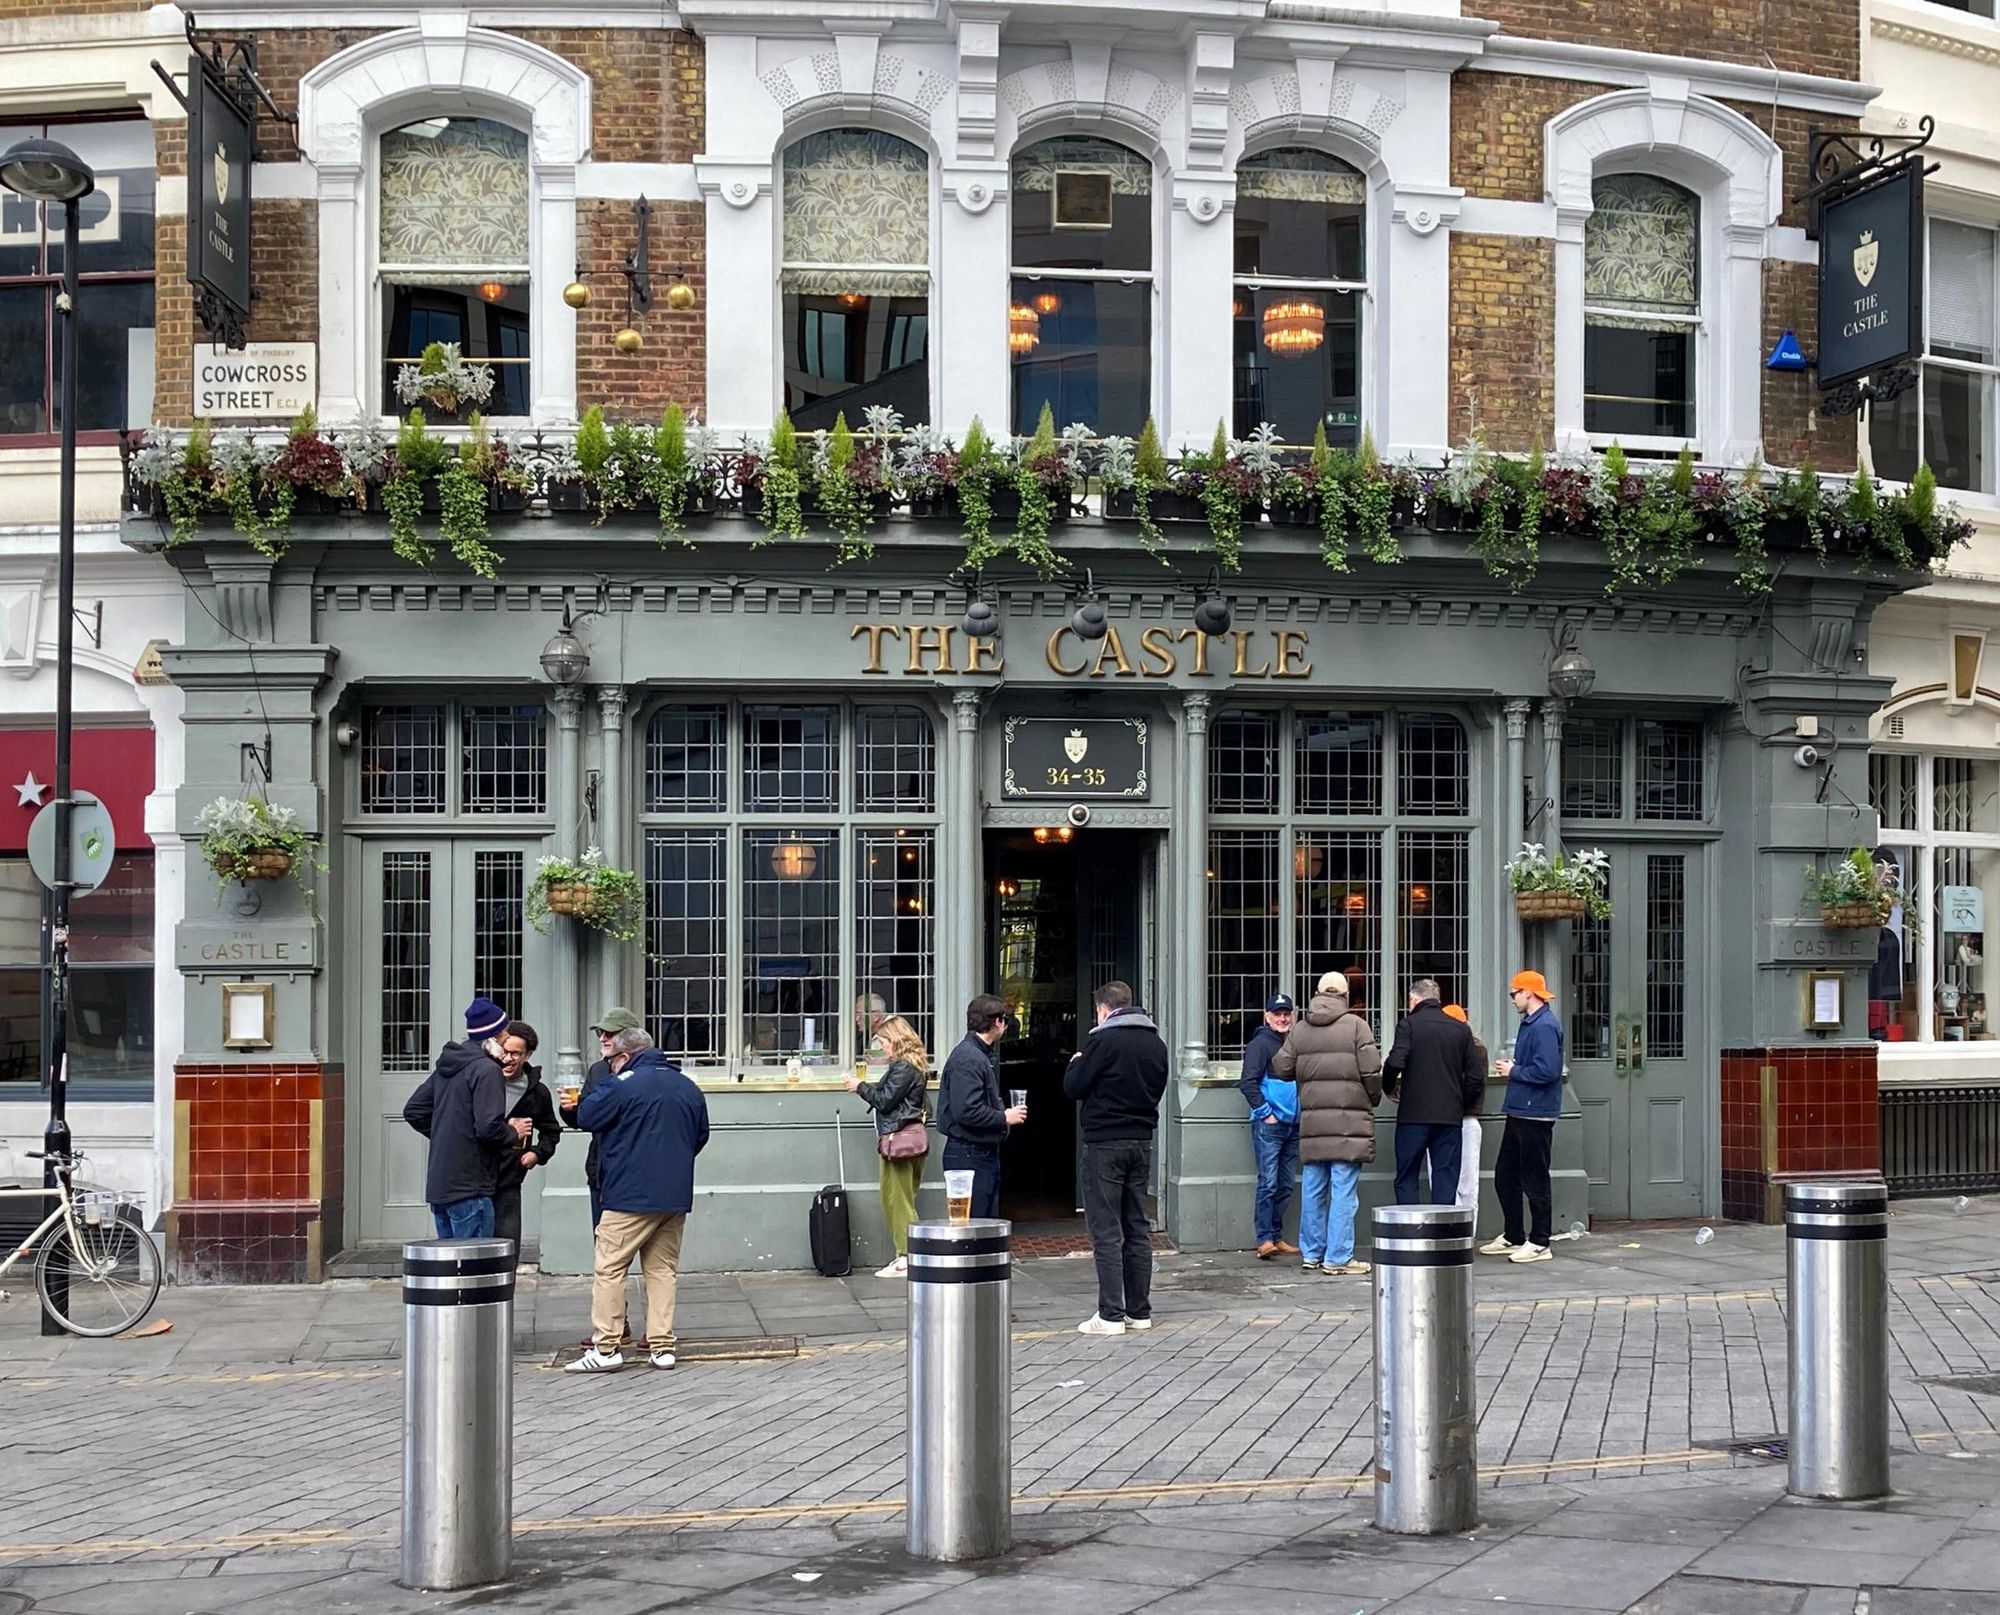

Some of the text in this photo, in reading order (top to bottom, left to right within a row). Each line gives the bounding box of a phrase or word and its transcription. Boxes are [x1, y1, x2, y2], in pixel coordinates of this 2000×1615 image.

[214, 210, 229, 237] THE
[208, 229, 235, 264] CASTLE
[1853, 293, 1878, 314] THE
[1843, 309, 1889, 338] CASTLE
[202, 364, 308, 383] COWCROSS
[202, 390, 274, 410] STREET
[850, 624, 1313, 679] THE CASTLE
[1046, 767, 1106, 786] 34-35
[201, 942, 290, 961] CASTLE
[1793, 939, 1863, 956] CASTLE
